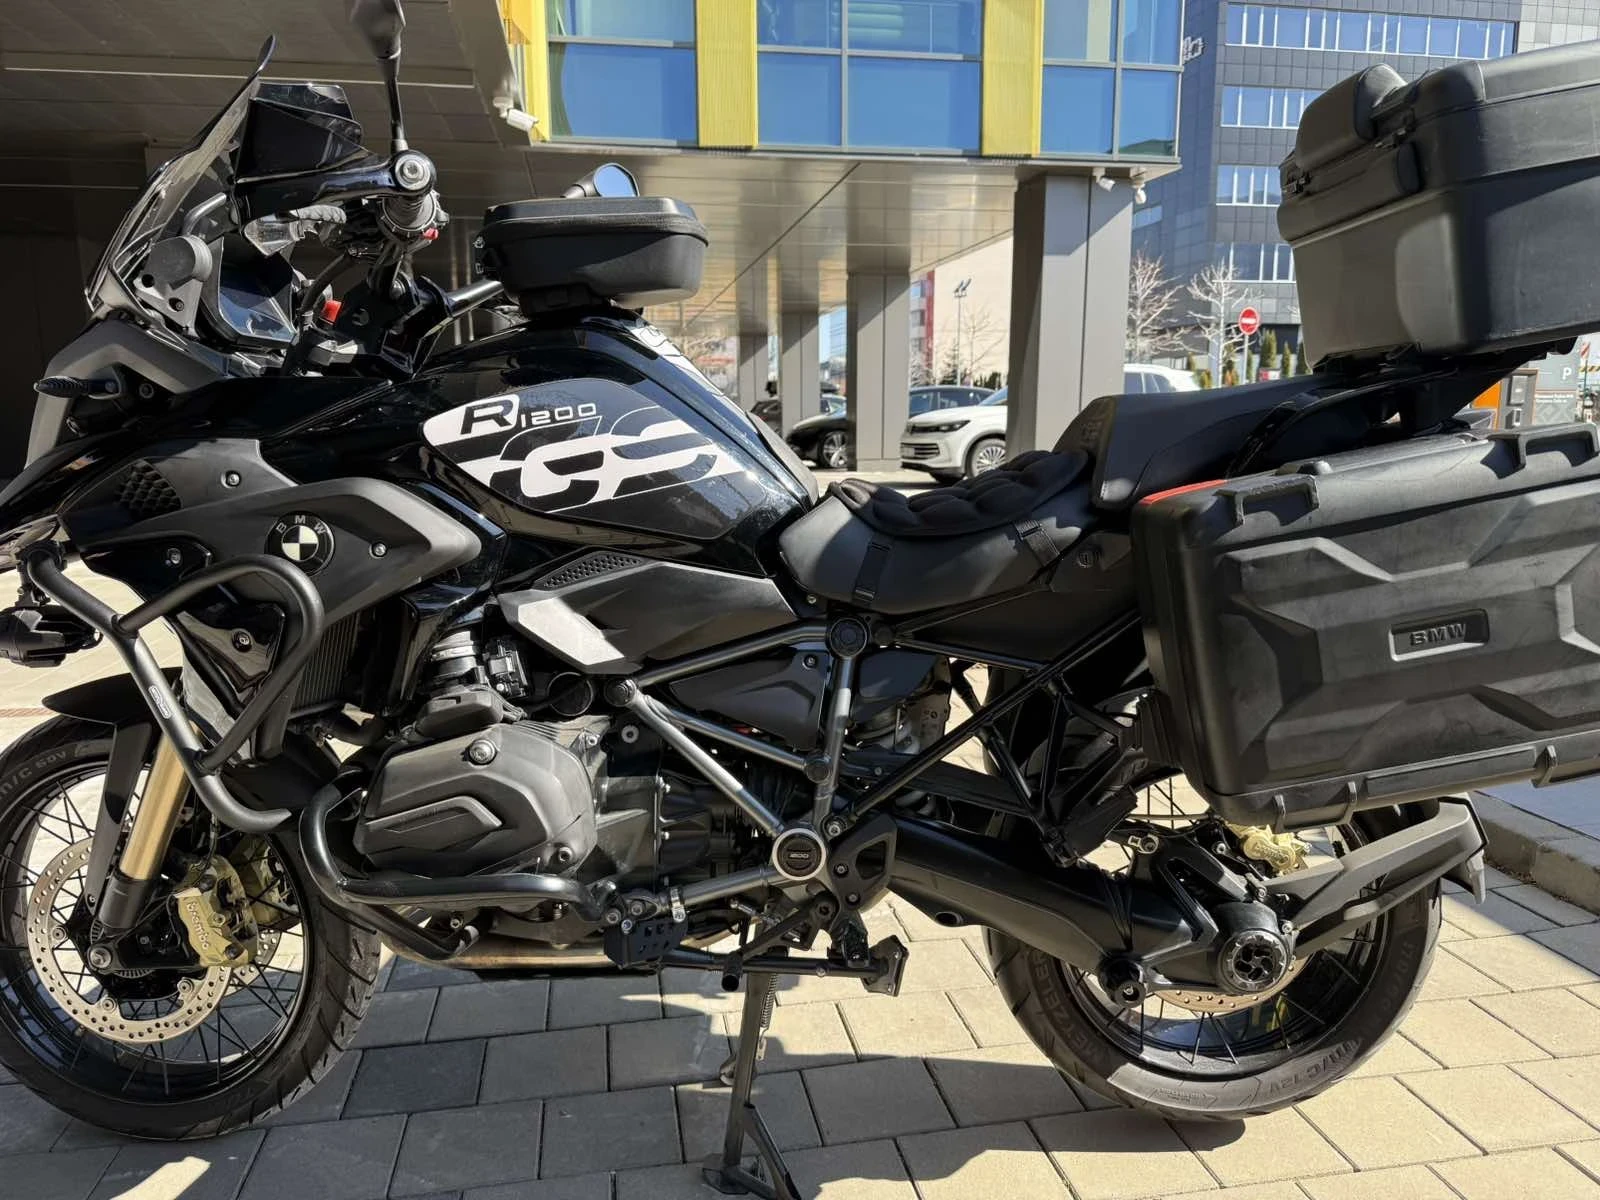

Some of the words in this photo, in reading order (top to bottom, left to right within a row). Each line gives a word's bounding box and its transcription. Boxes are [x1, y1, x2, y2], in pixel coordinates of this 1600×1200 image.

[461, 400, 516, 435] R
[521, 403, 597, 428] 1200
[275, 515, 326, 535] BMW
[1410, 623, 1466, 646] BMW
[186, 901, 210, 950] brembo
